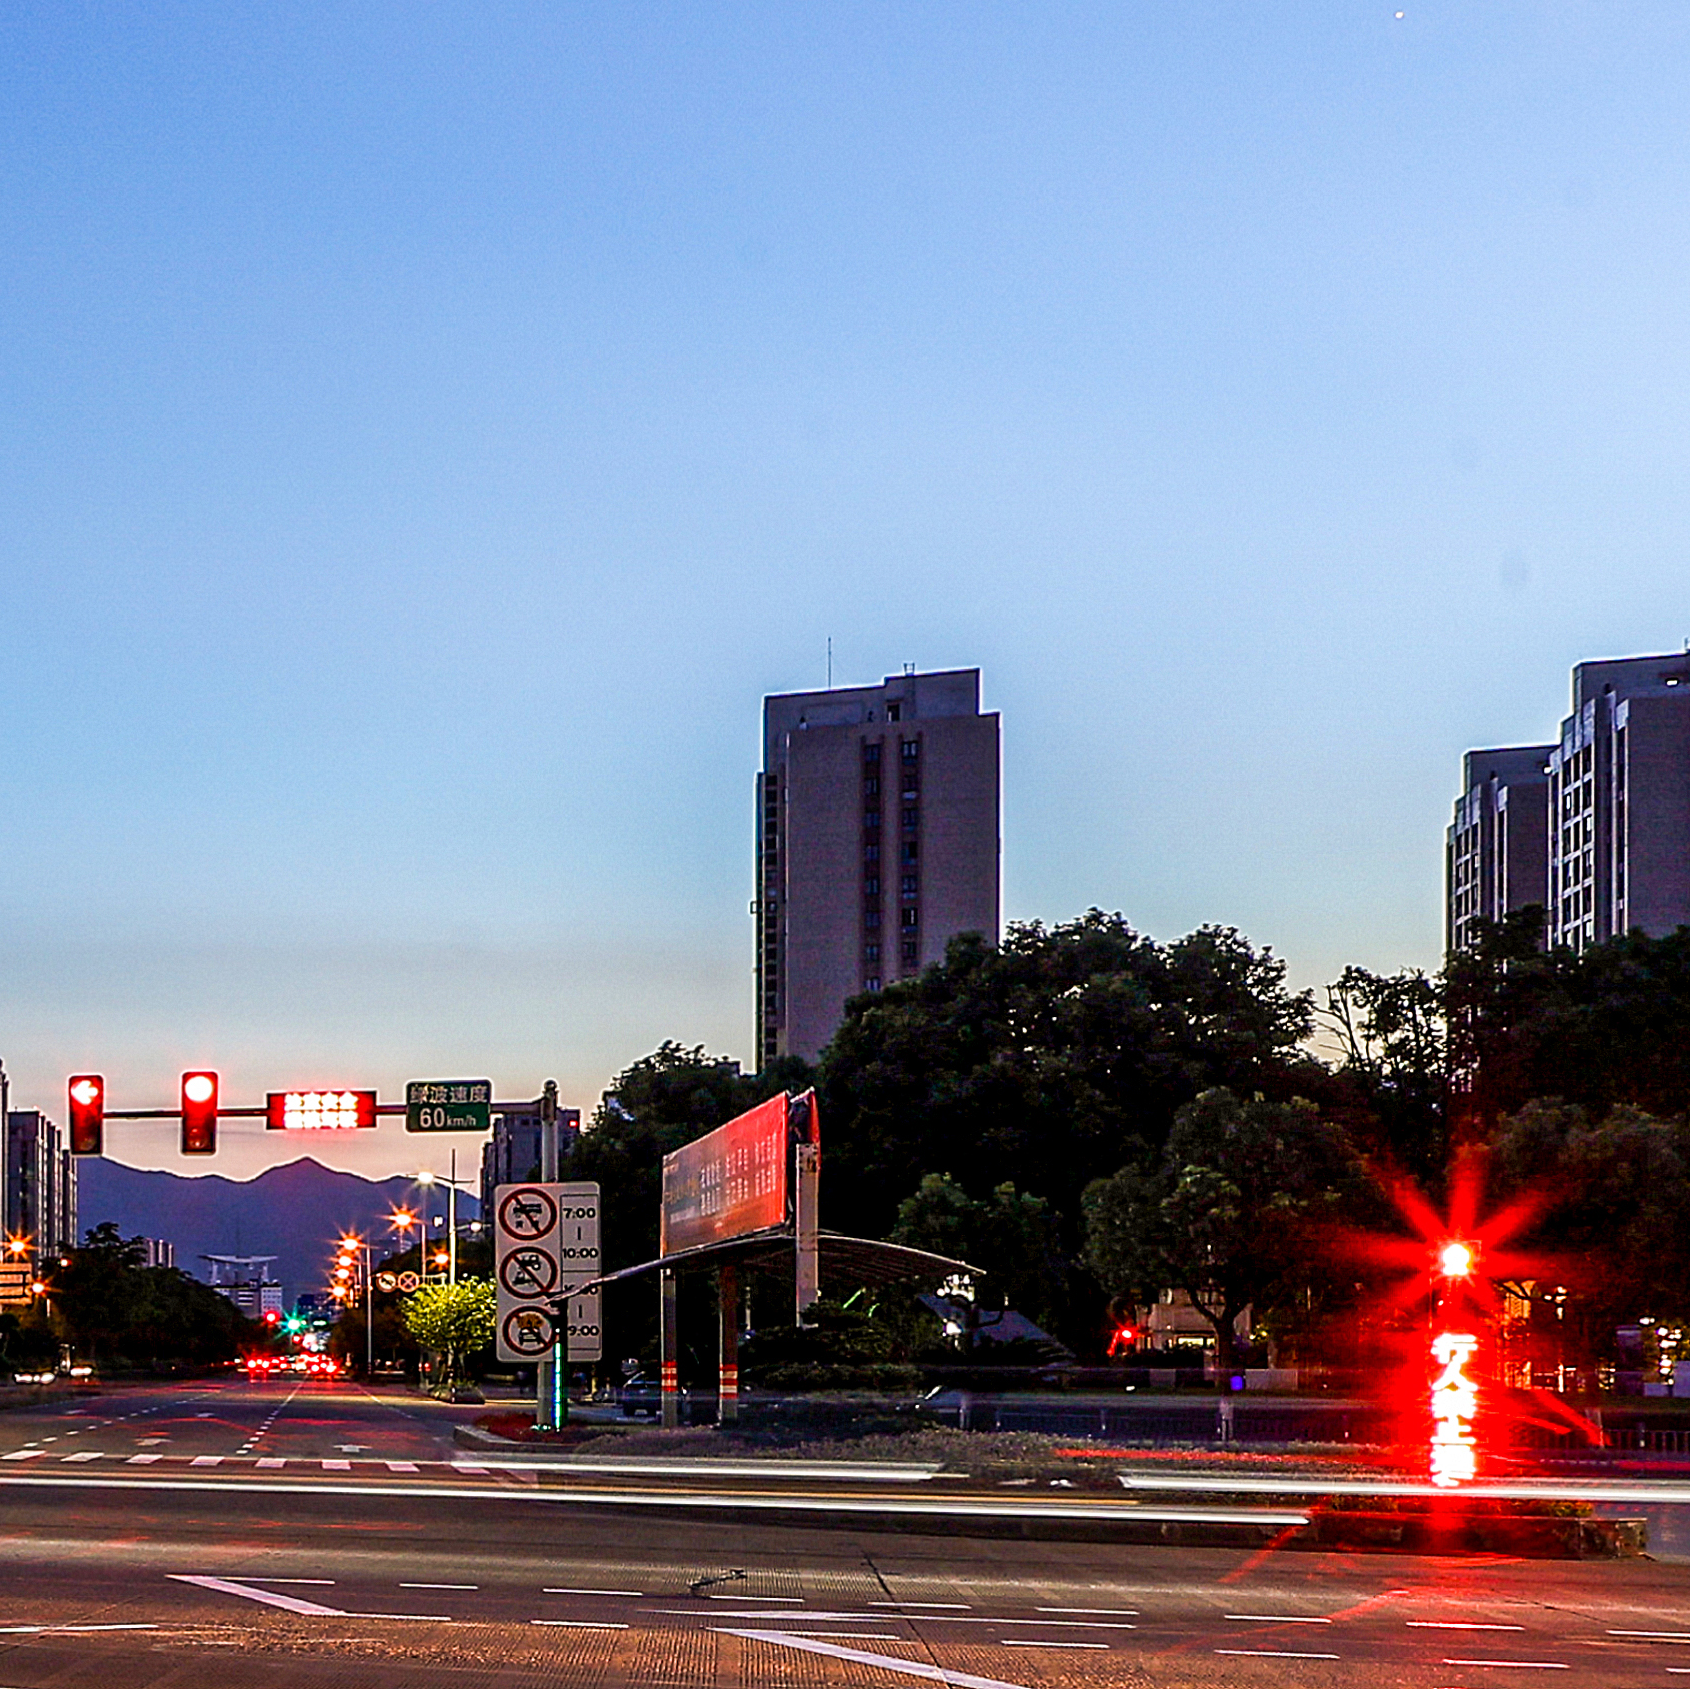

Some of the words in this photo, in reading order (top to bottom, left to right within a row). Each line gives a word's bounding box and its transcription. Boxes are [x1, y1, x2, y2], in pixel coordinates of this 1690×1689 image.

[563, 1207, 596, 1219] 7:00
[562, 1247, 598, 1259] 10:00
[567, 1325, 600, 1336] 9:00
